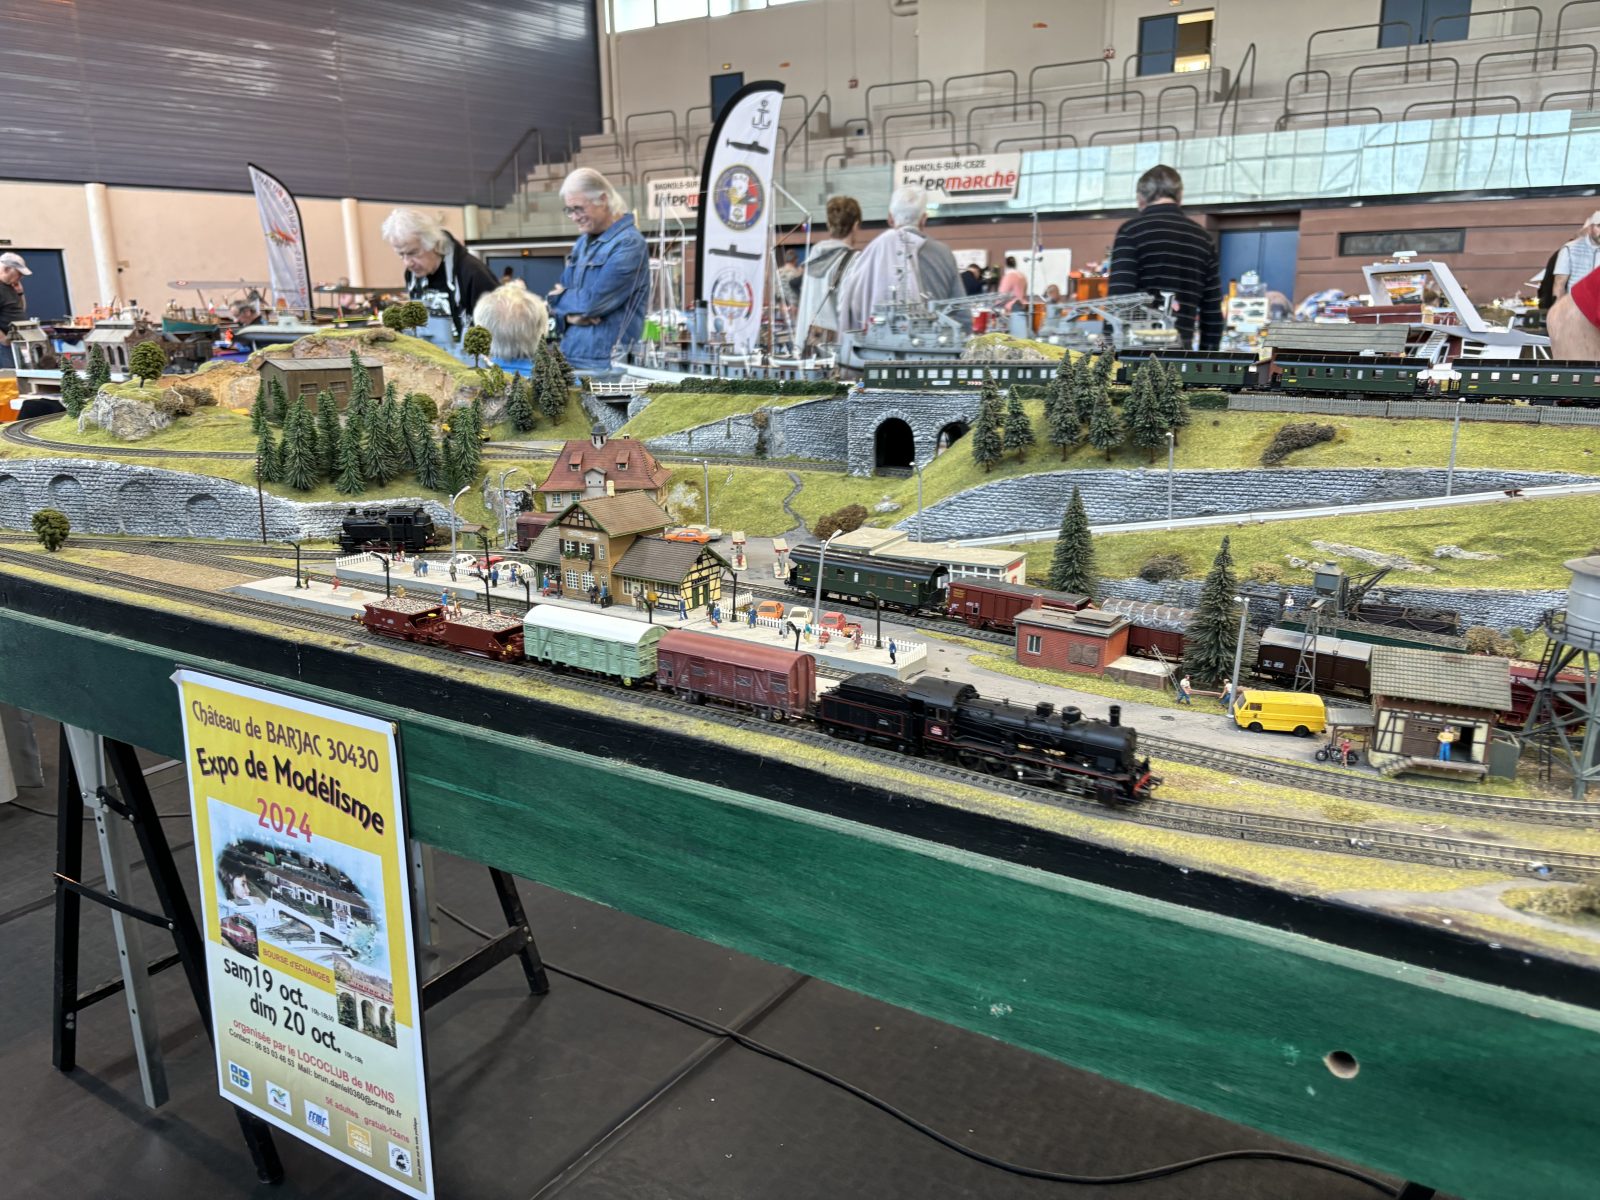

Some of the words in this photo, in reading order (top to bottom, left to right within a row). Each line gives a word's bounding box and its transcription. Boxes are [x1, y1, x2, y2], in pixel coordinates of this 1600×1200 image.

[192, 700, 241, 733] Château
[245, 717, 262, 740] de
[266, 721, 322, 757] BARJAC
[326, 738, 379, 773] 30430
[196, 748, 239, 784] Expo
[245, 750, 268, 781] de
[273, 755, 385, 836] Modélisme
[257, 798, 313, 843] 2024
[262, 948, 289, 966] BOURSE
[250, 992, 277, 1027] dim
[283, 1006, 305, 1036] 20
[311, 1026, 342, 1054] oct.
[280, 984, 309, 1010] oct.
[233, 1019, 272, 1045] organisée
[272, 1039, 287, 1054] par
[288, 1045, 296, 1057] le
[297, 1048, 350, 1082] LOCOCLUB
[351, 1075, 363, 1089] de
[365, 1080, 396, 1104] MONS
